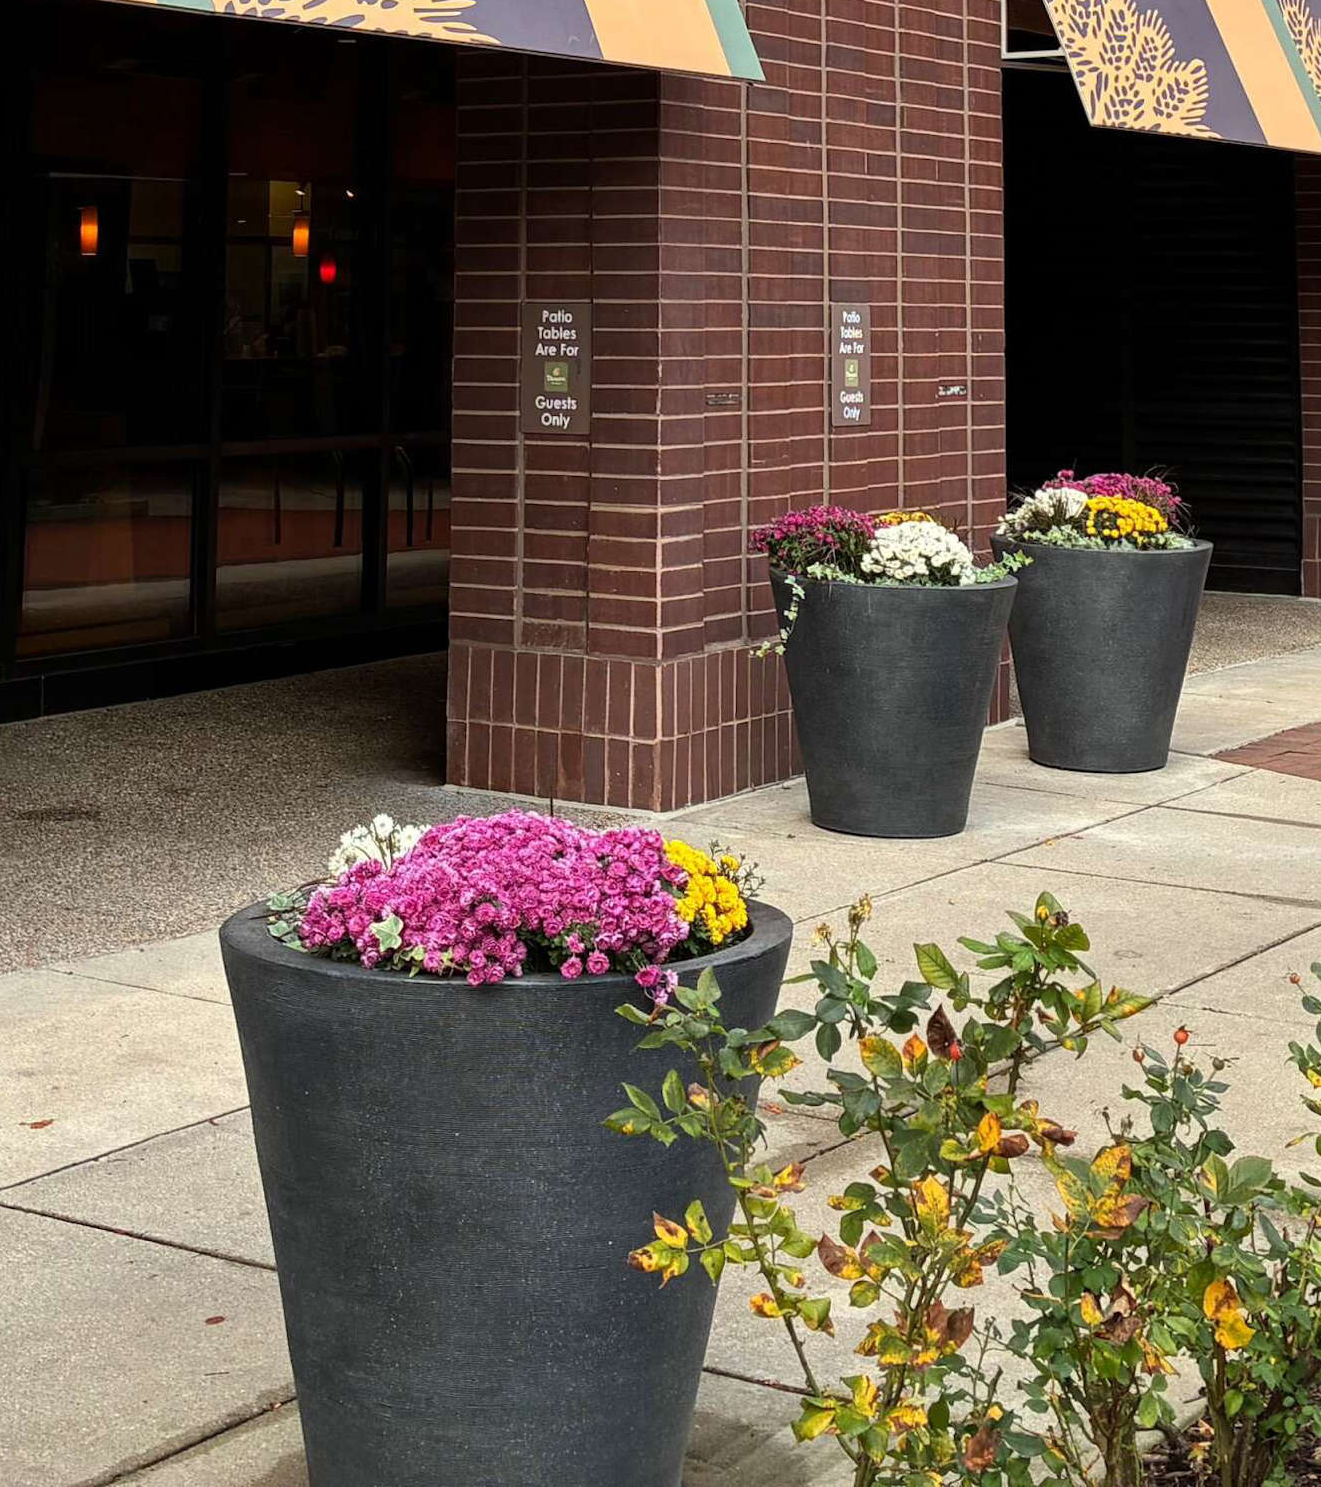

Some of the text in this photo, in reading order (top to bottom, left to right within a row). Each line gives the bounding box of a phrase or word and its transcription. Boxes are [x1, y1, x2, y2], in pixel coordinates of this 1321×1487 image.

[542, 310, 573, 323] Patio
[538, 326, 576, 340] Tables
[535, 343, 579, 356] Are For
[535, 396, 577, 410] Guests
[541, 413, 570, 429] Only
